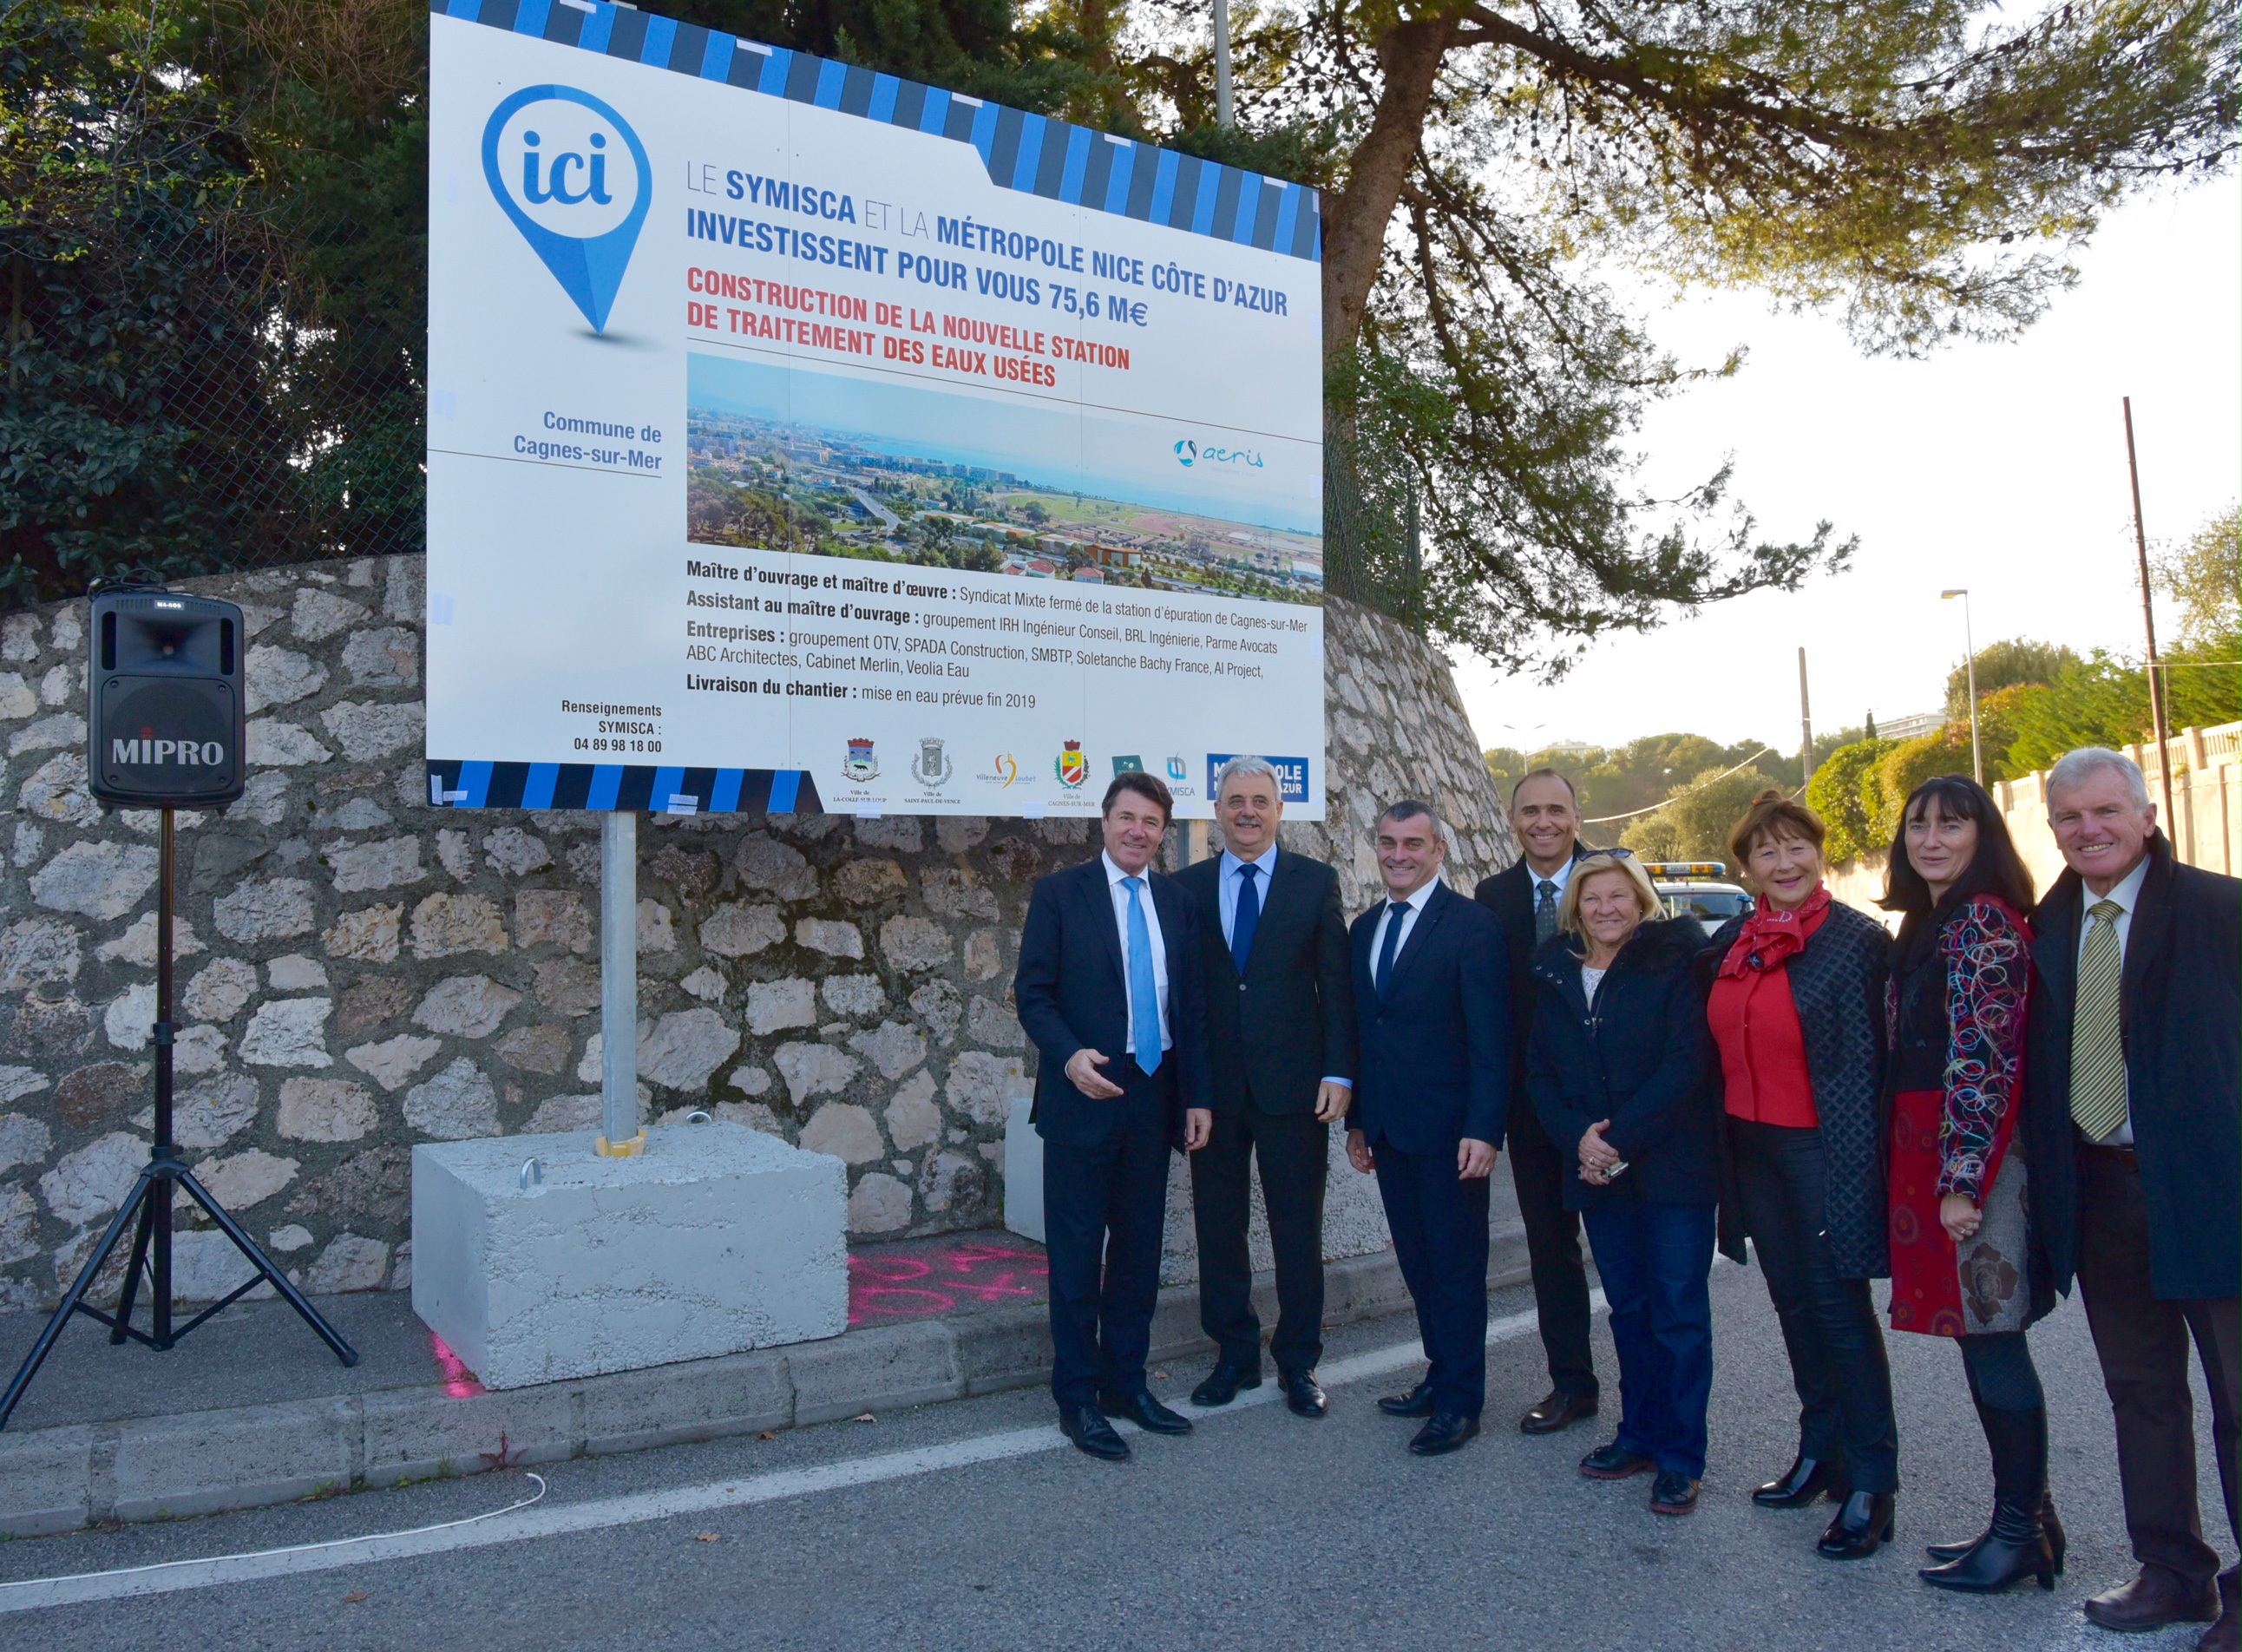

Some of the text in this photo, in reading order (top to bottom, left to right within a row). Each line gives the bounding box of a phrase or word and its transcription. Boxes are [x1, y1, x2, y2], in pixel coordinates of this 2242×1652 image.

[522, 130, 613, 205] ici
[687, 160, 1288, 318] LE SYMISCA ET LA MÉTROPOLE NICE CÔTE D'AZUR
[687, 207, 1148, 327] INVESTISSENT POUR VOUS 75,6 M€
[687, 266, 1130, 370] CONSTRUCTION DE LA NOUVELLE STATION
[688, 301, 1056, 388] DE TRAITEMENT DES EAUX USÉES
[543, 410, 662, 443] Commune de
[514, 435, 662, 469] Cagnes-sur-Mer
[1203, 448, 1263, 468] aeris
[686, 560, 738, 580] Maître
[744, 566, 818, 590] d'ouvrage
[823, 574, 838, 590] et
[842, 576, 888, 594] maître
[893, 580, 947, 600] d'œuvre
[960, 586, 1012, 606] Syndicat
[1014, 591, 1046, 608] Mixte
[1049, 594, 1082, 612] fermé
[1085, 599, 1099, 613] de
[1102, 600, 1112, 614] la
[1115, 602, 1151, 618] station
[1154, 606, 1212, 624] d'épuration
[1215, 612, 1228, 626] de
[1230, 613, 1308, 633] Cagnes-sur-Mer
[686, 589, 760, 612] Assistant
[764, 600, 783, 613] au
[787, 600, 836, 618] maître
[840, 603, 910, 626] d'ouvrage
[923, 613, 996, 631] groupement
[1000, 617, 1019, 633] IRH
[1023, 619, 1076, 638] Ingénieur
[1079, 624, 1122, 643] Conseil,
[1124, 627, 1147, 643] BRL
[1150, 630, 1203, 650] Ingénierie,
[1206, 635, 1237, 651] Parme
[1239, 638, 1278, 654] Avocats
[686, 620, 776, 644] Entreprises
[789, 628, 869, 650] groupement
[873, 634, 901, 653] OTV,
[904, 637, 947, 655] SPADA
[950, 640, 1028, 663] Construction,
[1031, 646, 1073, 666] SMBTP,
[1076, 650, 1137, 669] Soletanche
[1140, 655, 1172, 674] Bachy
[1175, 658, 1212, 676] France,
[1227, 662, 1263, 679] Project,
[686, 644, 969, 678] ABC Architectes, Cabinet Merlin, Veolia Eau
[561, 699, 662, 717] Renseignements
[686, 673, 757, 694] Livraison
[763, 678, 781, 695] du
[785, 679, 849, 698] chantier
[862, 685, 892, 701] mise
[896, 690, 912, 702] en
[915, 691, 938, 704] eau
[942, 689, 983, 707] prévue
[987, 692, 1002, 707] fin
[1006, 693, 1036, 709] 2019
[599, 720, 654, 735] SYMISCA
[113, 738, 224, 765] MIPRO
[574, 738, 662, 753] 04 89 98 18 00
[1167, 786, 1196, 796] MISCA
